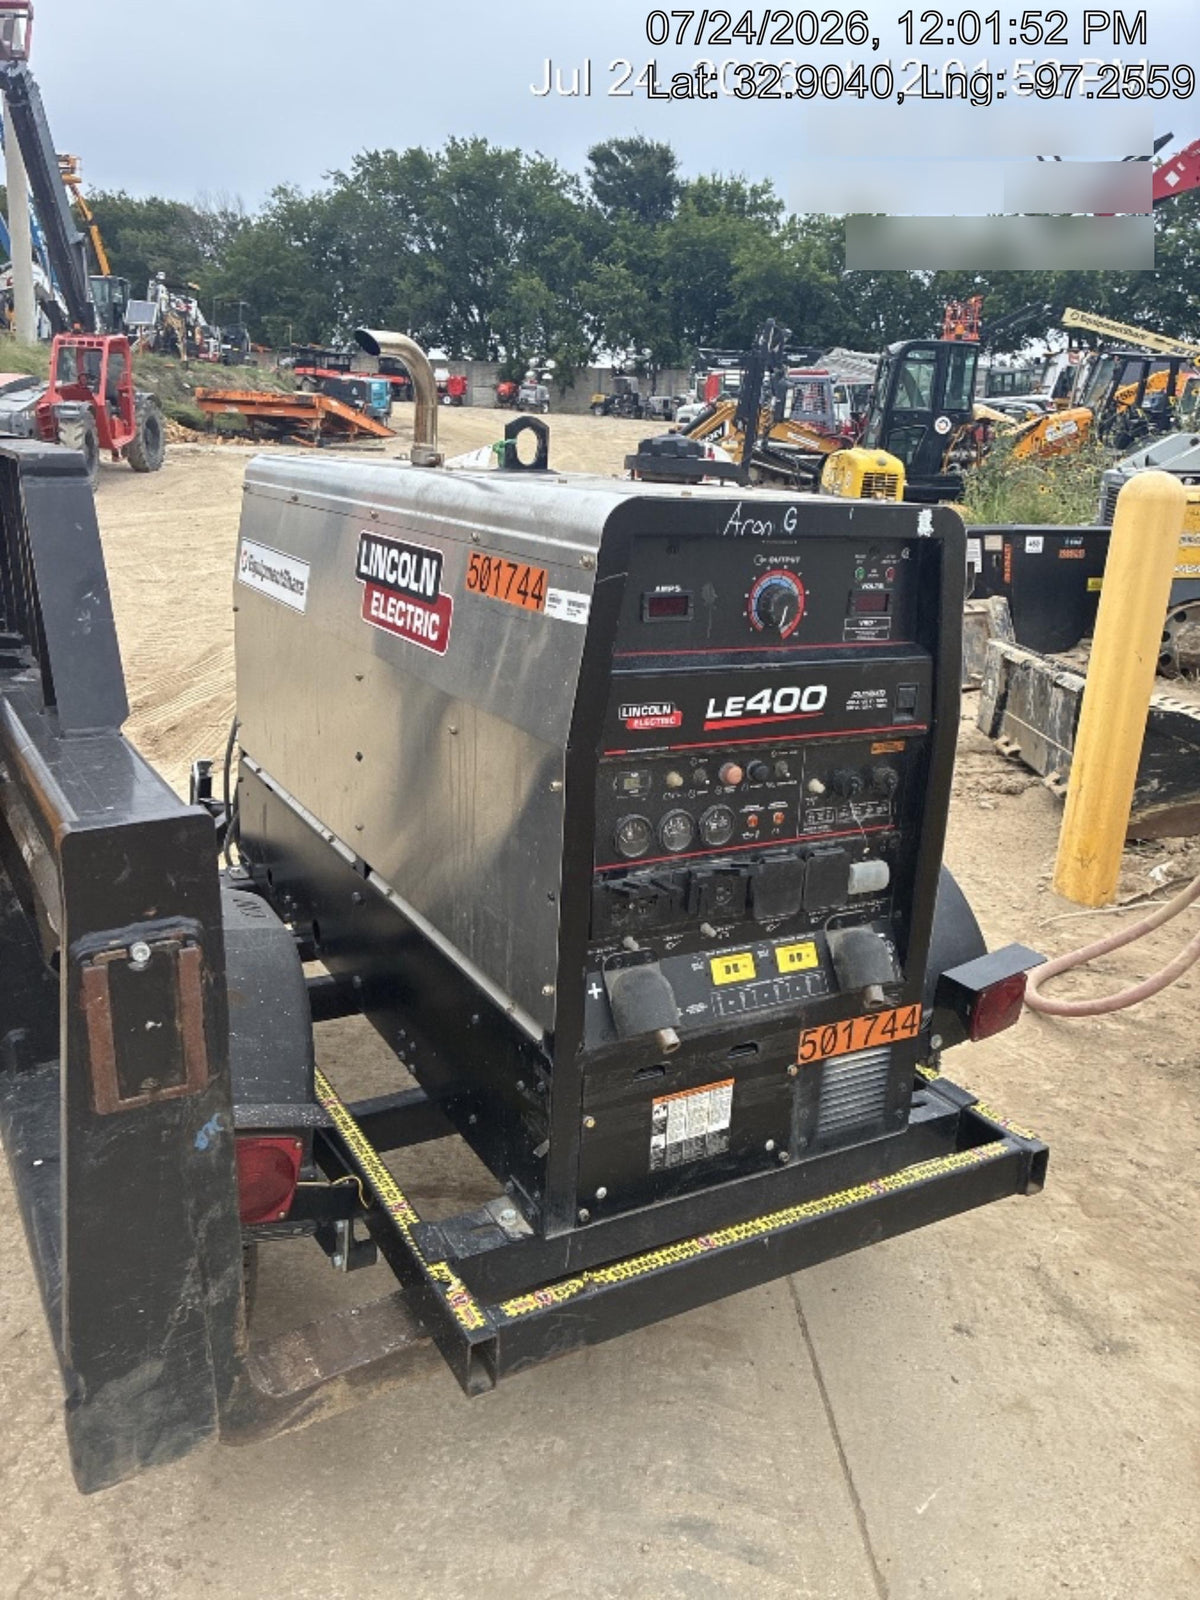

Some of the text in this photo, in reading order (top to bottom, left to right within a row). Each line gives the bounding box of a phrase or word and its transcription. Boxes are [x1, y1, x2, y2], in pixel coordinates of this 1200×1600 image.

[783, 506, 798, 535] G
[359, 543, 438, 598] LINCOLN
[467, 552, 546, 610] 501744
[655, 584, 682, 593] AMPS
[370, 594, 440, 641] ELECTRIC
[621, 703, 671, 718] LINCOLN
[705, 684, 828, 720] LE400
[633, 715, 676, 727] ELECTRIC
[799, 1006, 918, 1062] 501744
